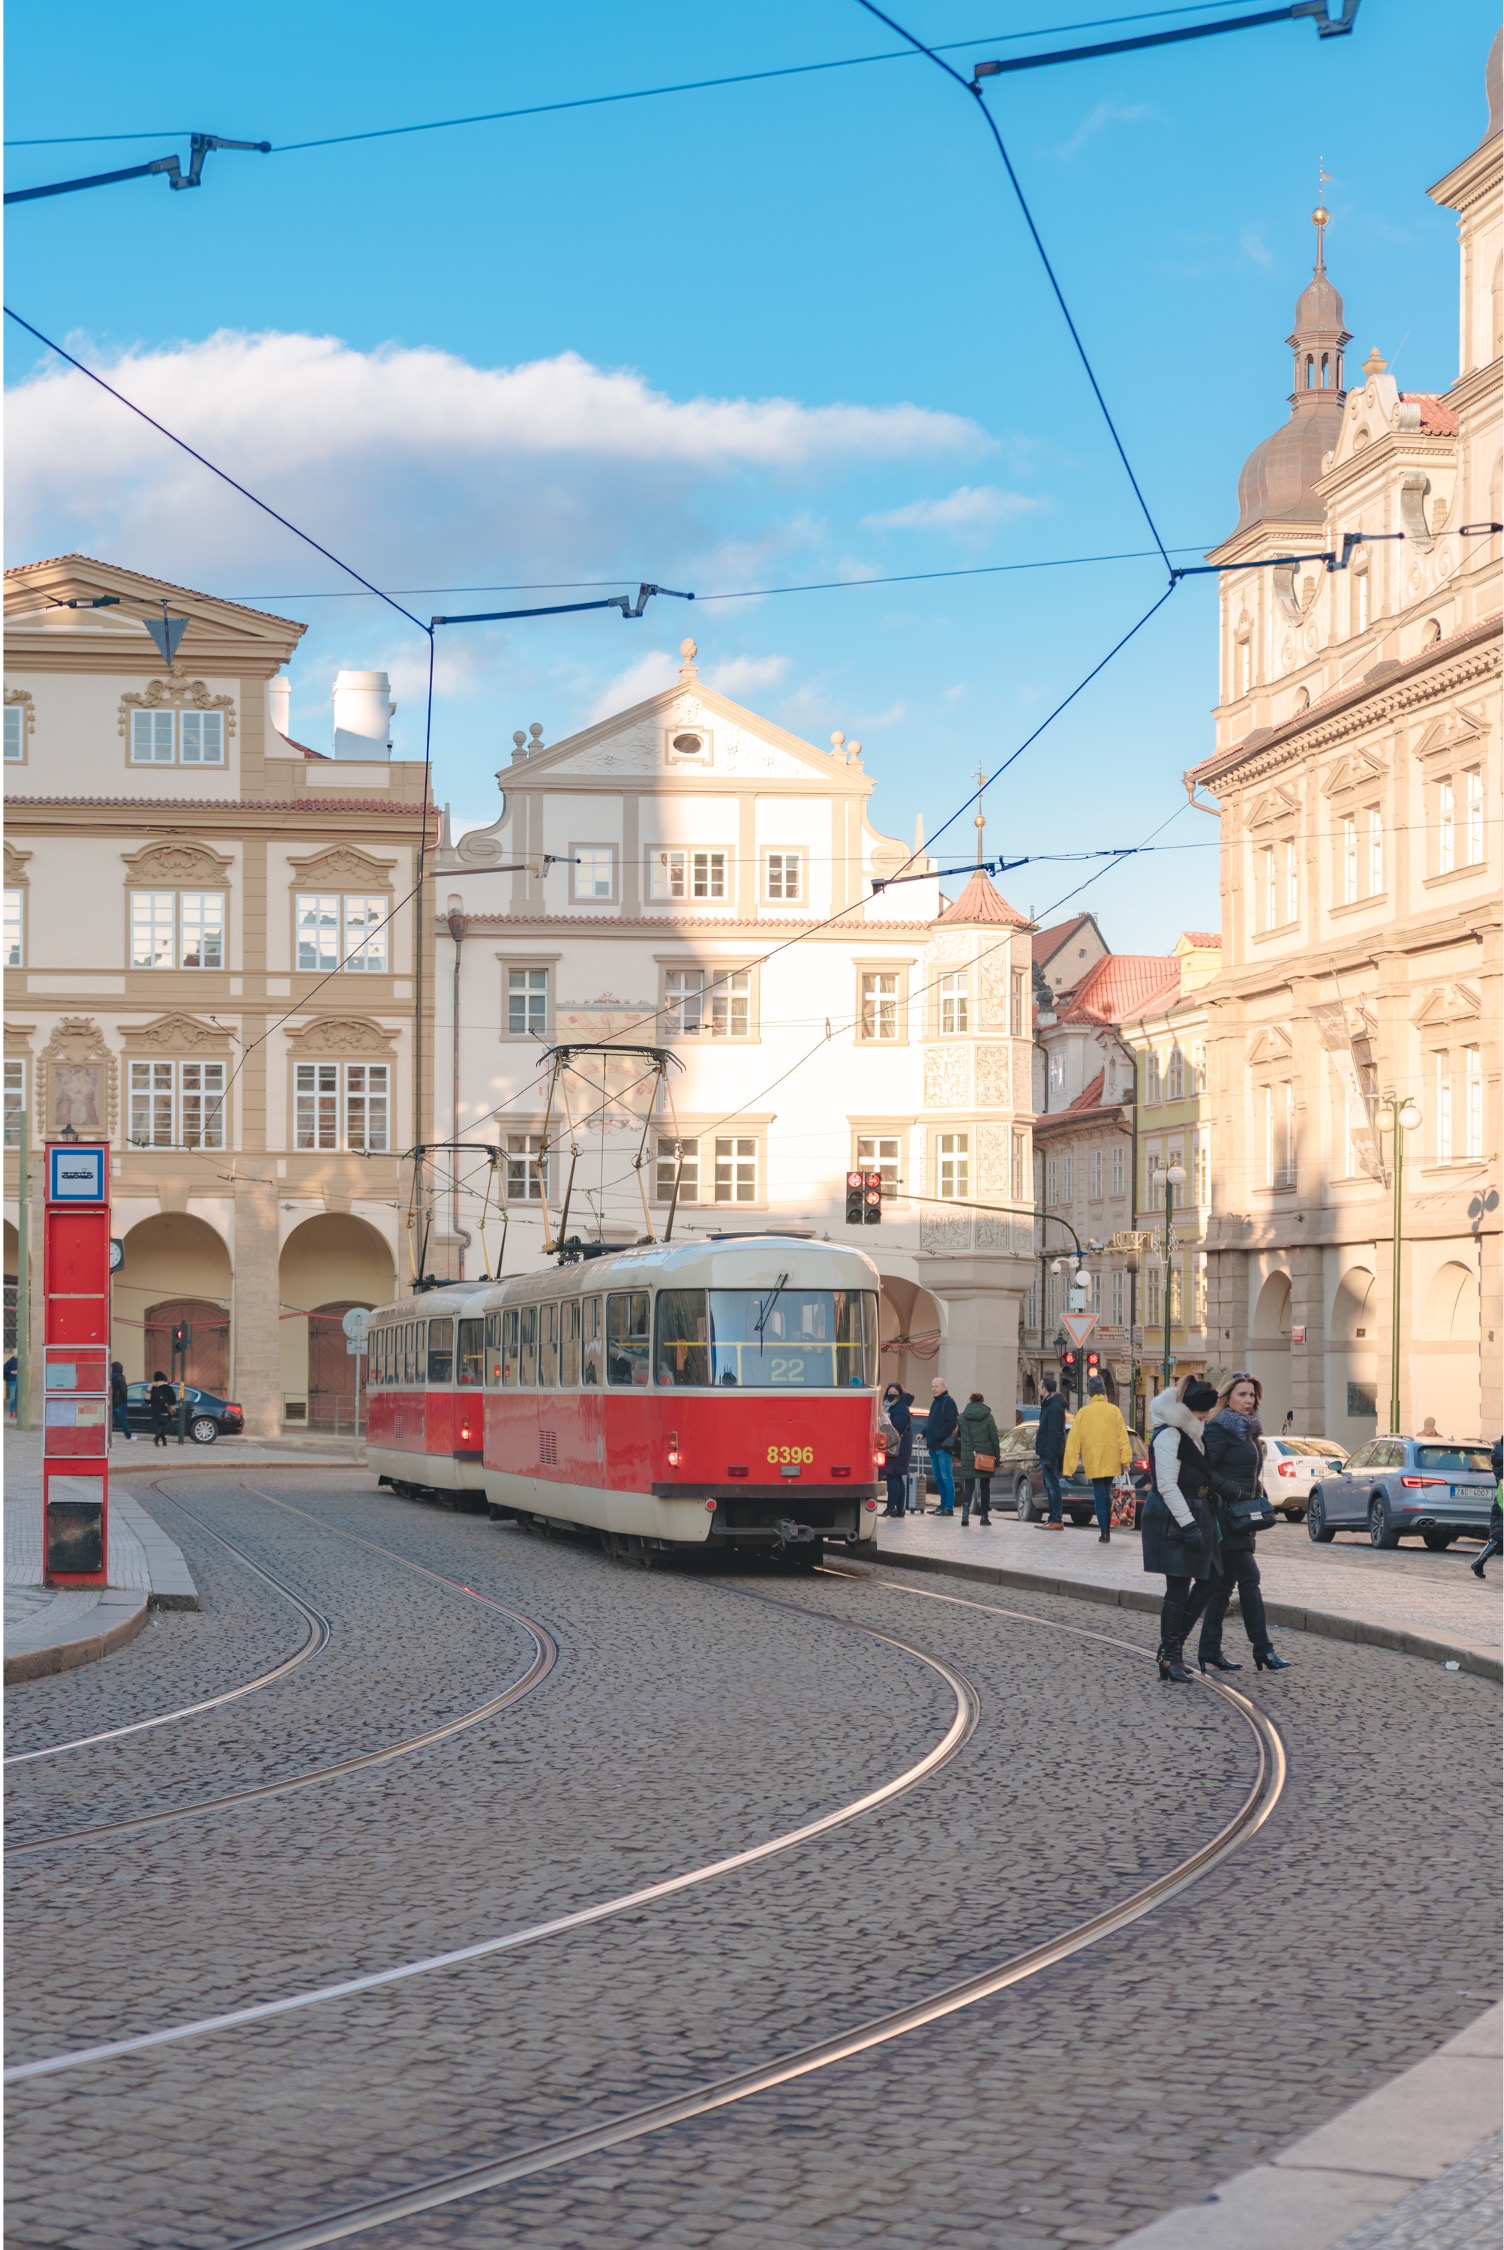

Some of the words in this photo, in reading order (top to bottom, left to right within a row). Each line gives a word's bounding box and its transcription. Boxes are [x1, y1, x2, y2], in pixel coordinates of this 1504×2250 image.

[770, 1359, 805, 1382] 22
[767, 1446, 813, 1464] 8396
[1456, 1488, 1469, 1496] 7AC
[1473, 1489, 1489, 1497] 4007
